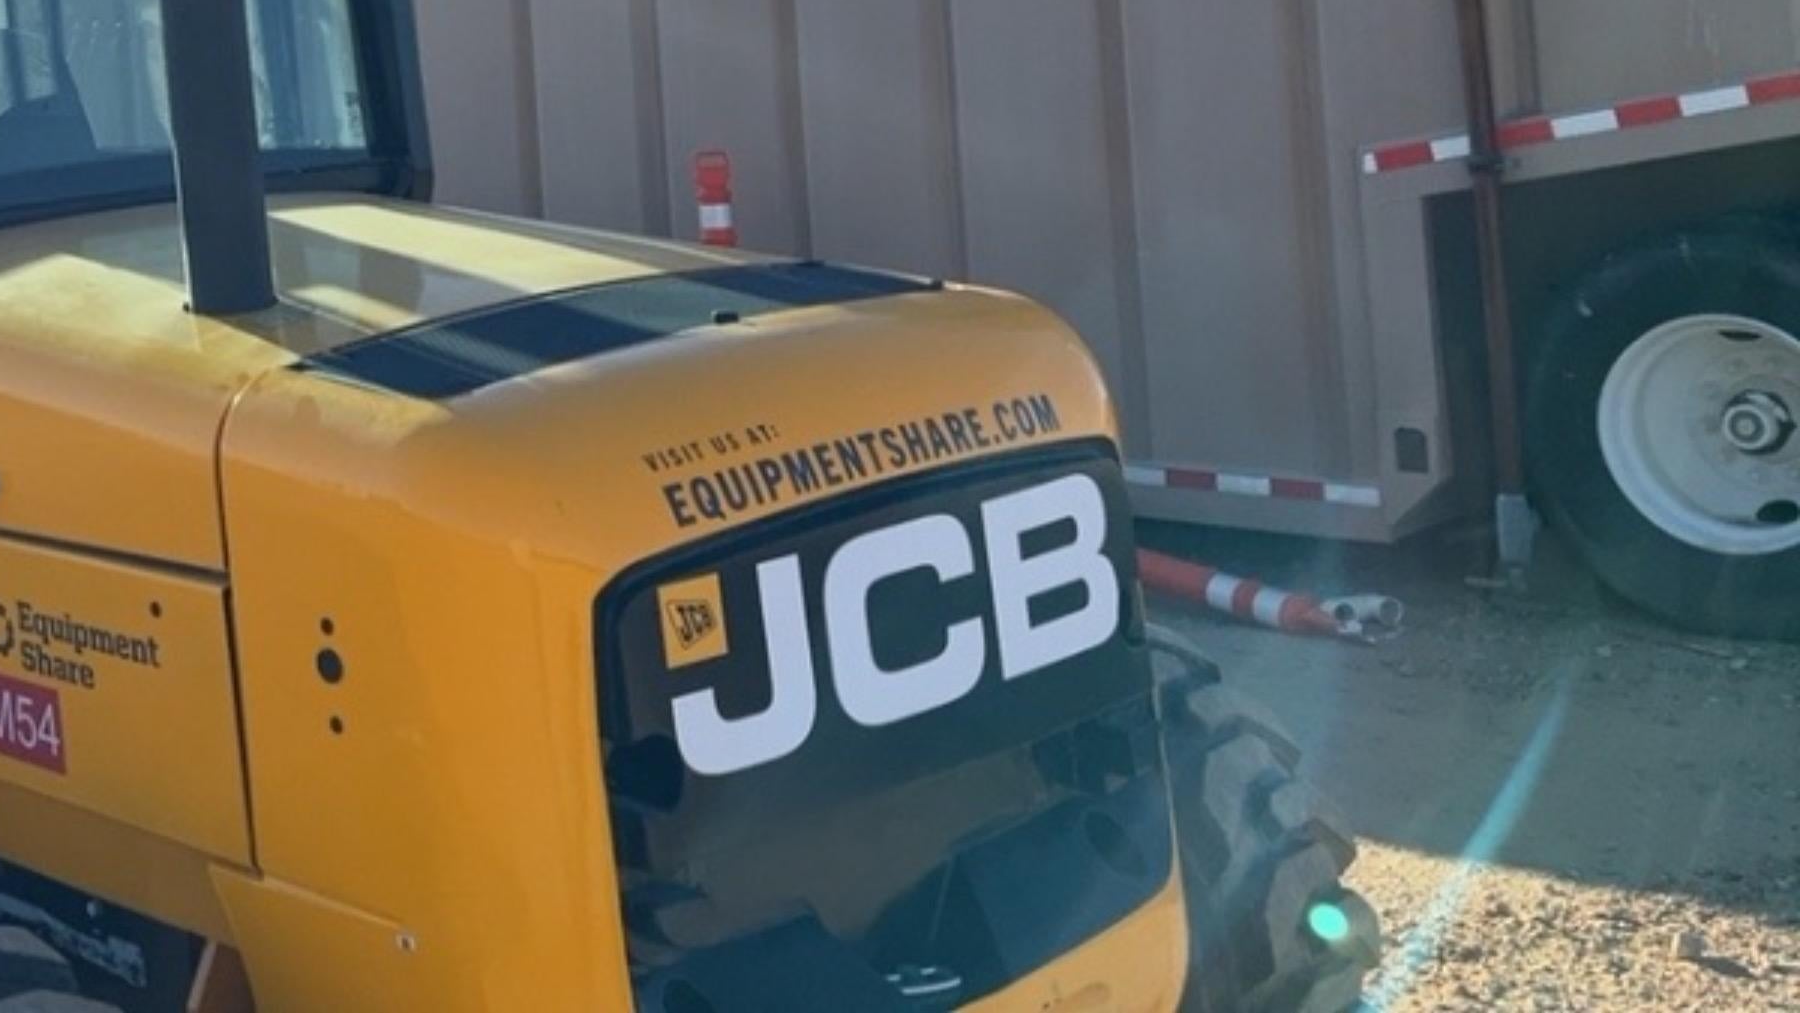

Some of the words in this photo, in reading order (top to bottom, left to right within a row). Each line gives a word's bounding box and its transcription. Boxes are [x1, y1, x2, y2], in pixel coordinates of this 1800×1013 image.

[642, 442, 704, 471] VISIT
[710, 432, 741, 455] US
[746, 424, 780, 445] AT:
[662, 394, 1062, 528] EQUIPMENTSHARE.COM
[16, 601, 161, 669] Equipment
[671, 472, 1121, 775] JCB
[22, 641, 95, 689] Share
